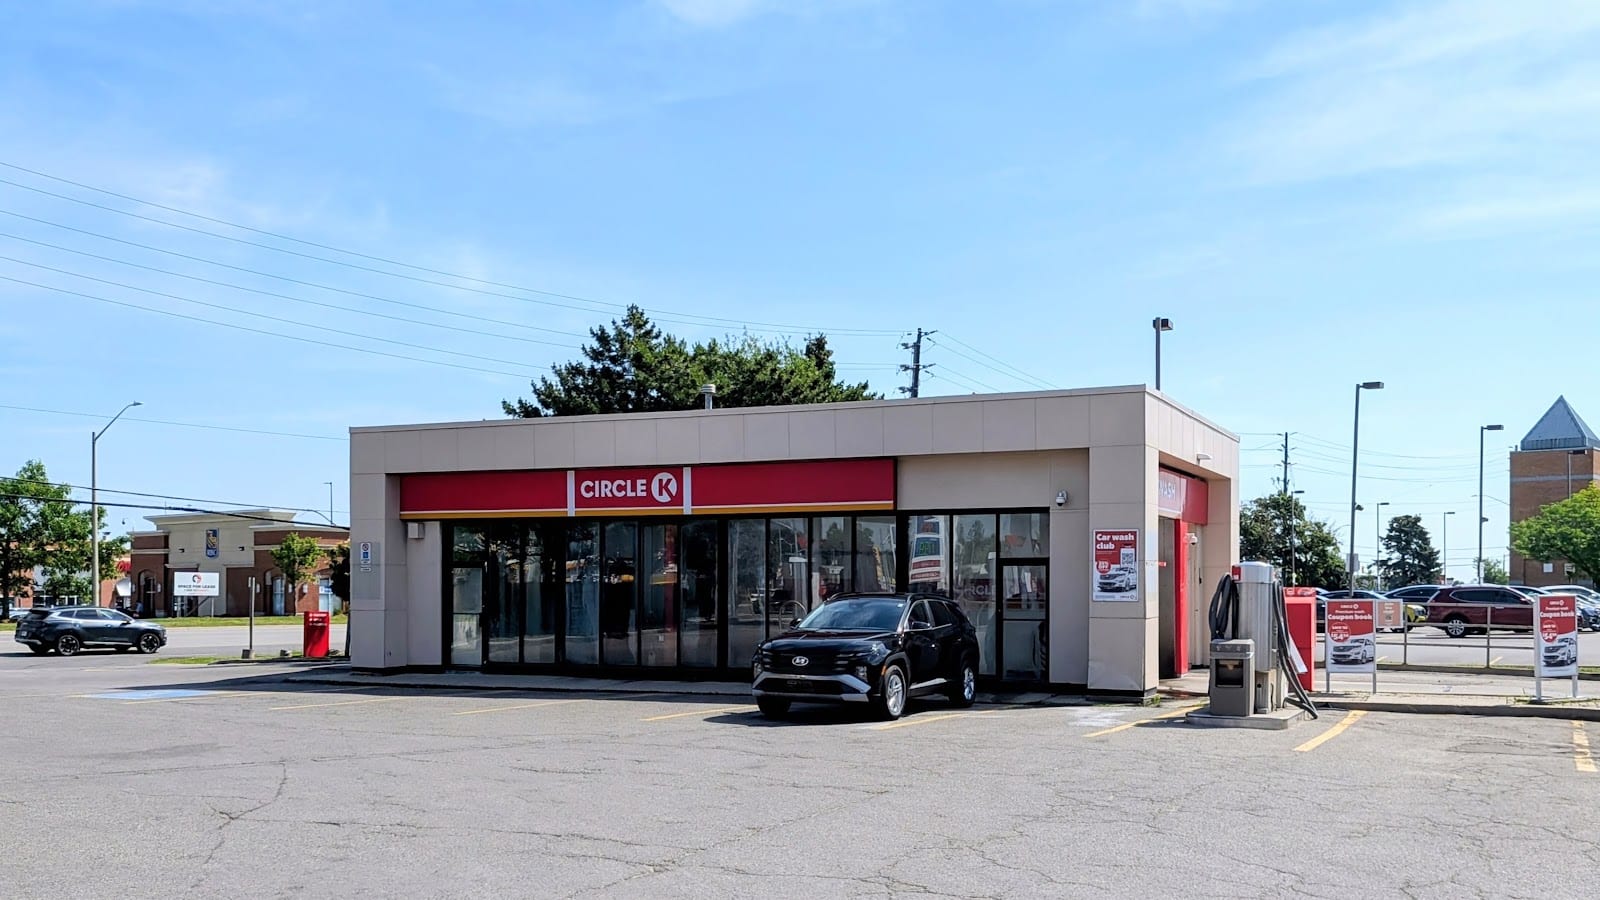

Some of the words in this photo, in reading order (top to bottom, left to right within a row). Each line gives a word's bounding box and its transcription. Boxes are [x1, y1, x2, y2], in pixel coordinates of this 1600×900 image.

[580, 479, 647, 499] CIRCLE
[653, 474, 677, 502] K
[1096, 533, 1110, 541] Car
[1111, 533, 1135, 541] wash
[1096, 542, 1115, 550] club
